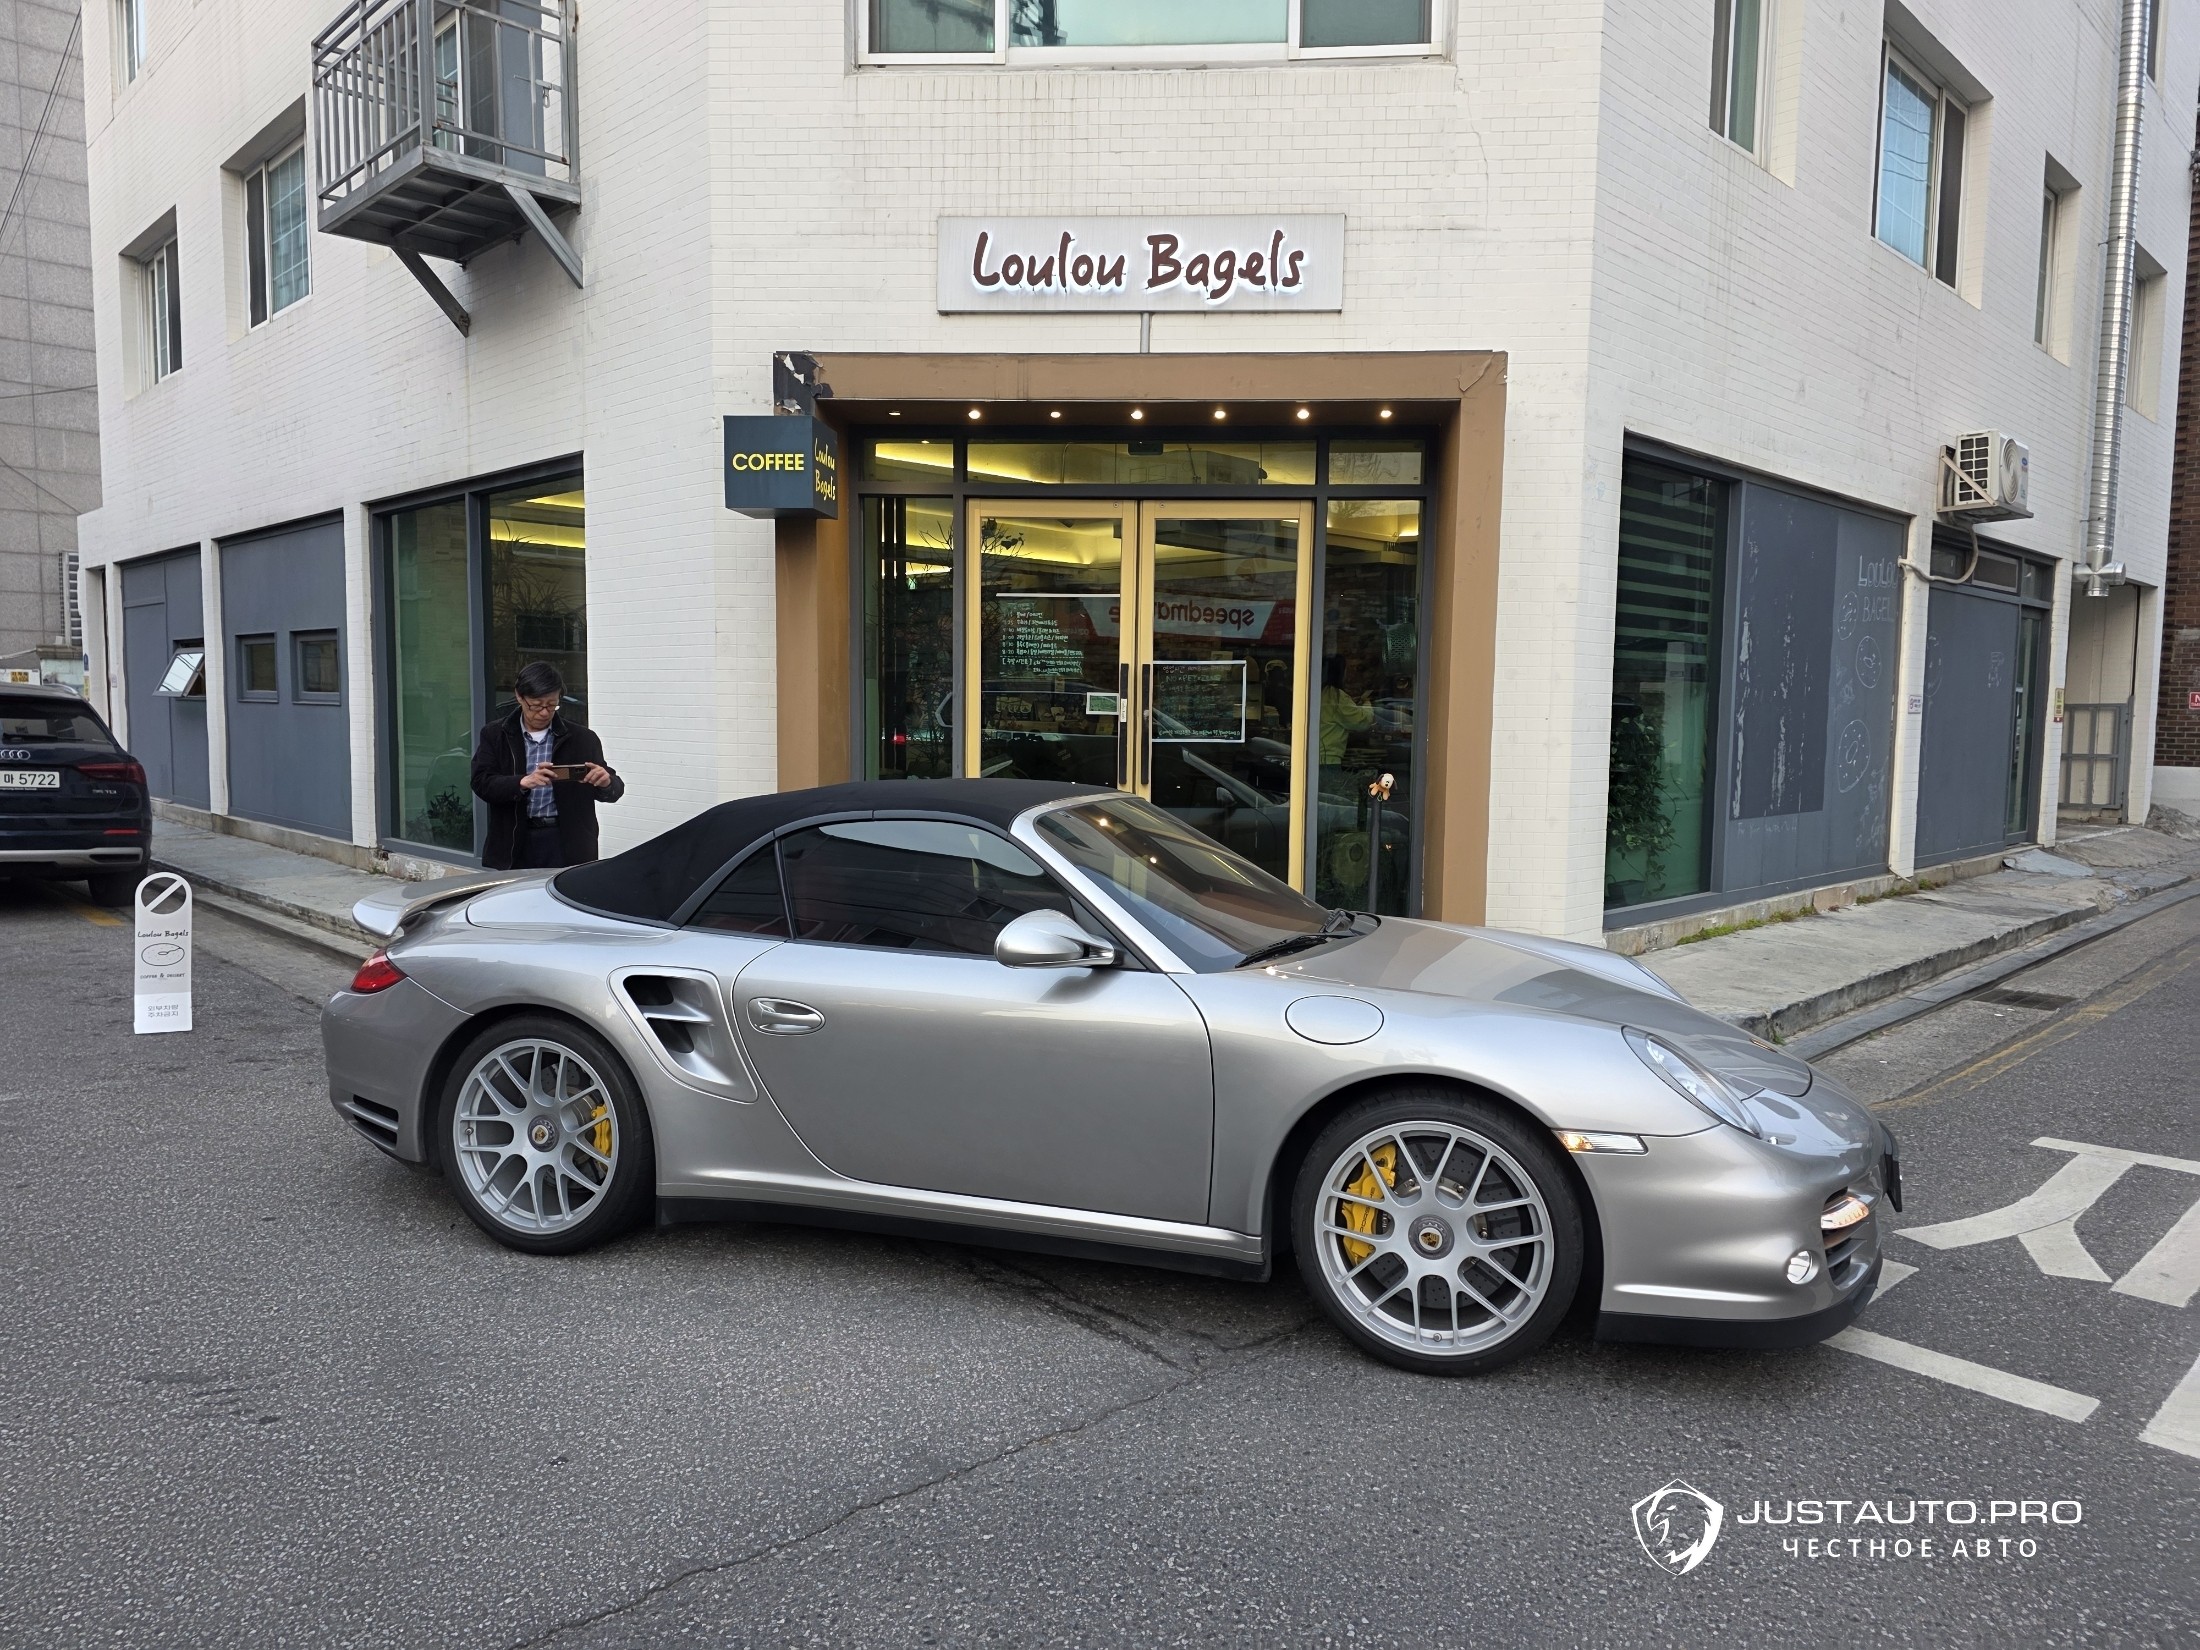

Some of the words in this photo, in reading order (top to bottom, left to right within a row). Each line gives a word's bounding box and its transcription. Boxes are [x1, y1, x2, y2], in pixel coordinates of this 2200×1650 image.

[973, 231, 1126, 288] Loulou
[1147, 229, 1305, 300] Bagels
[732, 453, 805, 471] COFFEE
[814, 437, 836, 471] Loulou
[815, 469, 836, 501] Bagels
[18, 773, 56, 786] 5722
[137, 930, 162, 938] Loulou
[164, 929, 189, 940] Bagels
